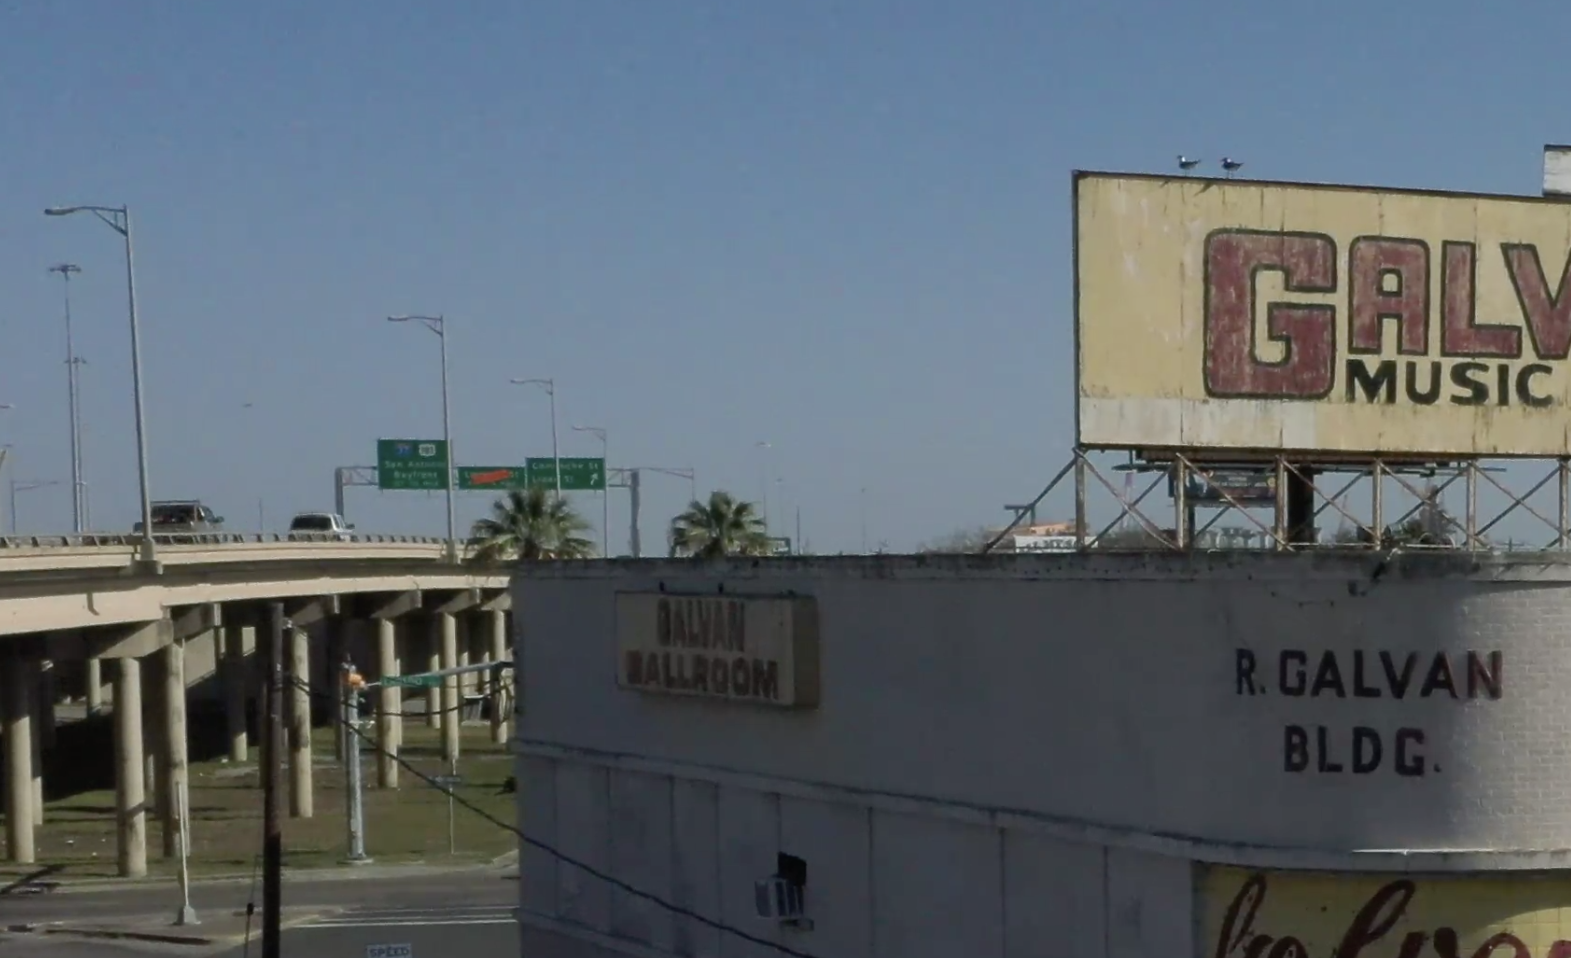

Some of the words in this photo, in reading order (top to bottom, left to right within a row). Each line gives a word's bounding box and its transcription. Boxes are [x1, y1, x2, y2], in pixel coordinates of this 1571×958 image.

[1344, 358, 1553, 406] MUSIC
[627, 650, 779, 700] BALLROOM
[1279, 649, 1503, 700] GALVAN
[1283, 725, 1442, 776] BLDG.
[370, 947, 409, 957] SPEED
